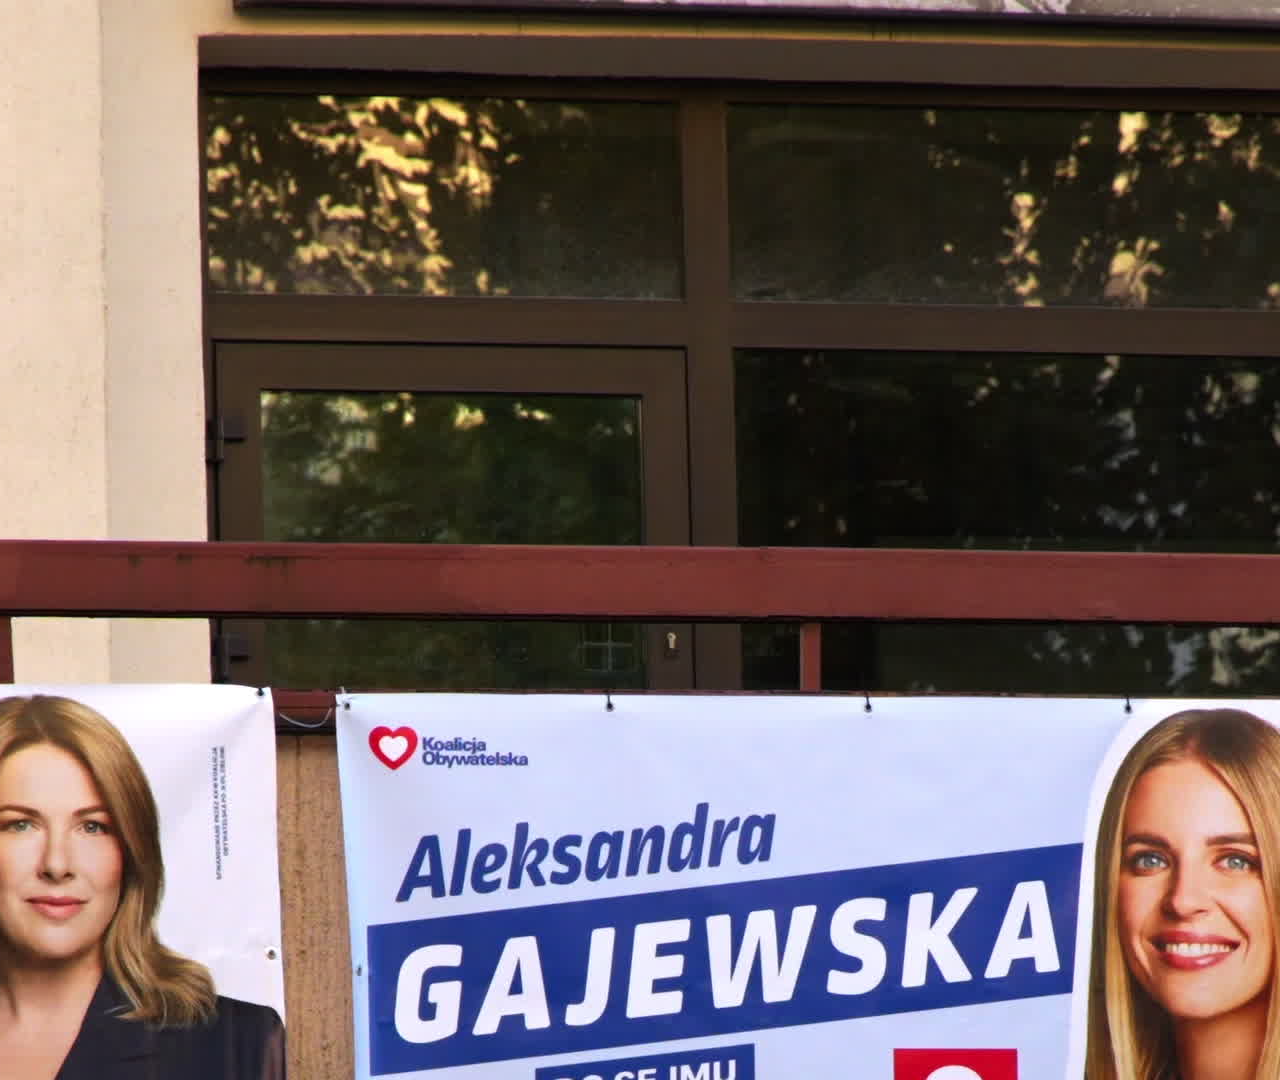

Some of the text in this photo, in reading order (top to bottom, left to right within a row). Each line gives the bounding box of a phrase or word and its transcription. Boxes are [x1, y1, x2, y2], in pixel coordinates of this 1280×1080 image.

[422, 737, 486, 754] Koalicja
[422, 751, 529, 768] Obywatelska
[395, 801, 777, 903] Aleksandra
[393, 879, 1061, 1044] GAJEWSKA
